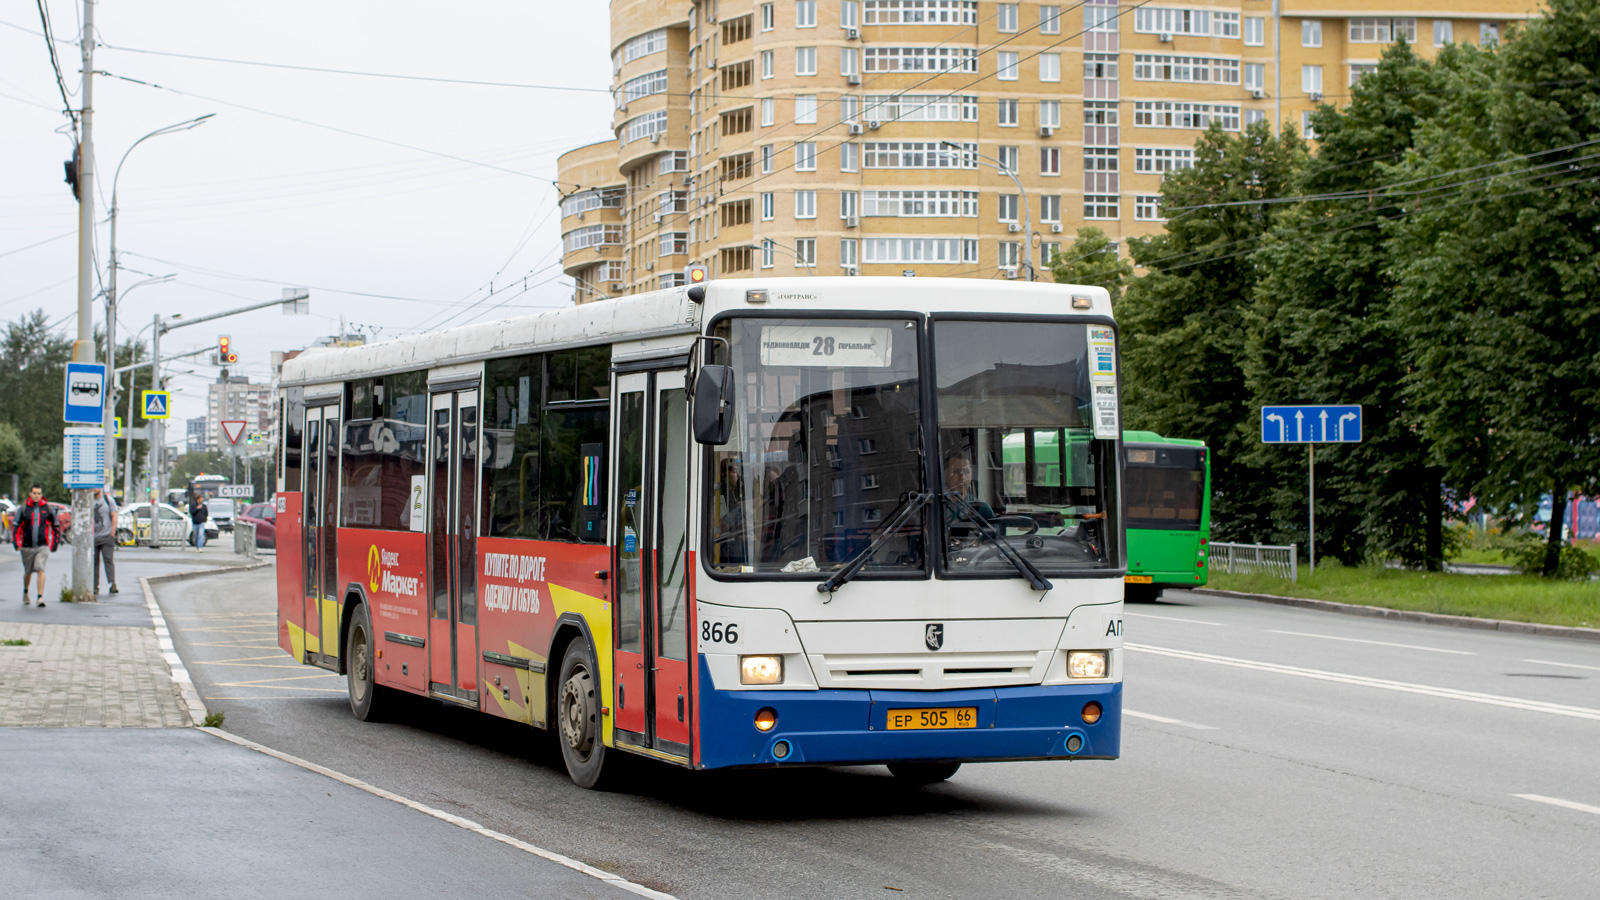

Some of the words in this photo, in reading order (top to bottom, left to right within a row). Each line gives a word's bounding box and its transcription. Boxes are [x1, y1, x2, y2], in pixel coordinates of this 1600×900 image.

[812, 336, 835, 356] 28
[221, 487, 250, 496] СТОП
[484, 552, 510, 578] КУПИТЕ
[509, 554, 519, 579] ПО
[518, 554, 547, 584] ДОРОГЕ
[381, 570, 419, 598] Маркет
[485, 583, 512, 613] ОДЕЖДУ
[511, 586, 518, 611] И
[518, 587, 540, 614] ОБУВЬ
[702, 620, 739, 645] 866
[920, 711, 948, 727] 505
[956, 709, 971, 722] 66
